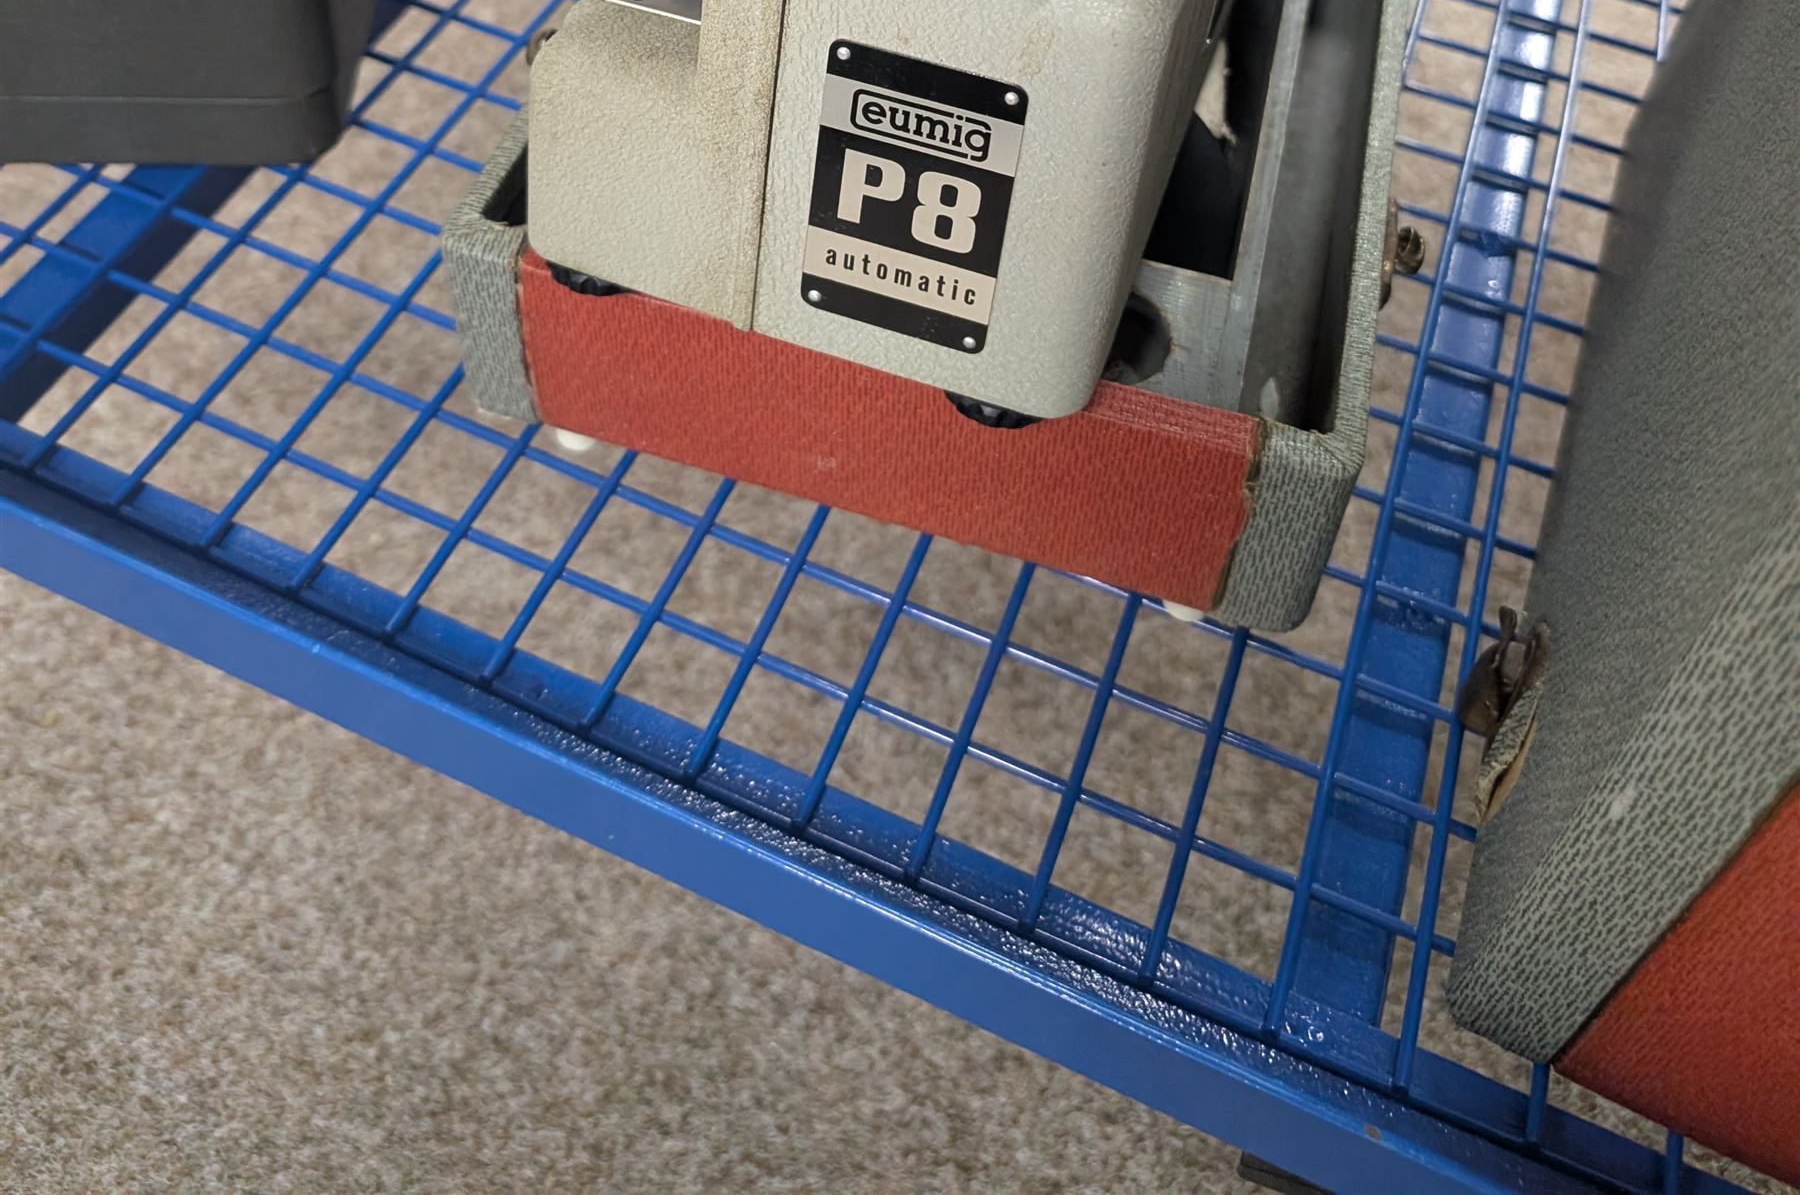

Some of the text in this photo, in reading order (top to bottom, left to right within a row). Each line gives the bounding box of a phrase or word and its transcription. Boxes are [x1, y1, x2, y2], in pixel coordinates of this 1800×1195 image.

[861, 100, 992, 163] eumig
[836, 147, 982, 254] P8
[825, 248, 977, 305] automatic
